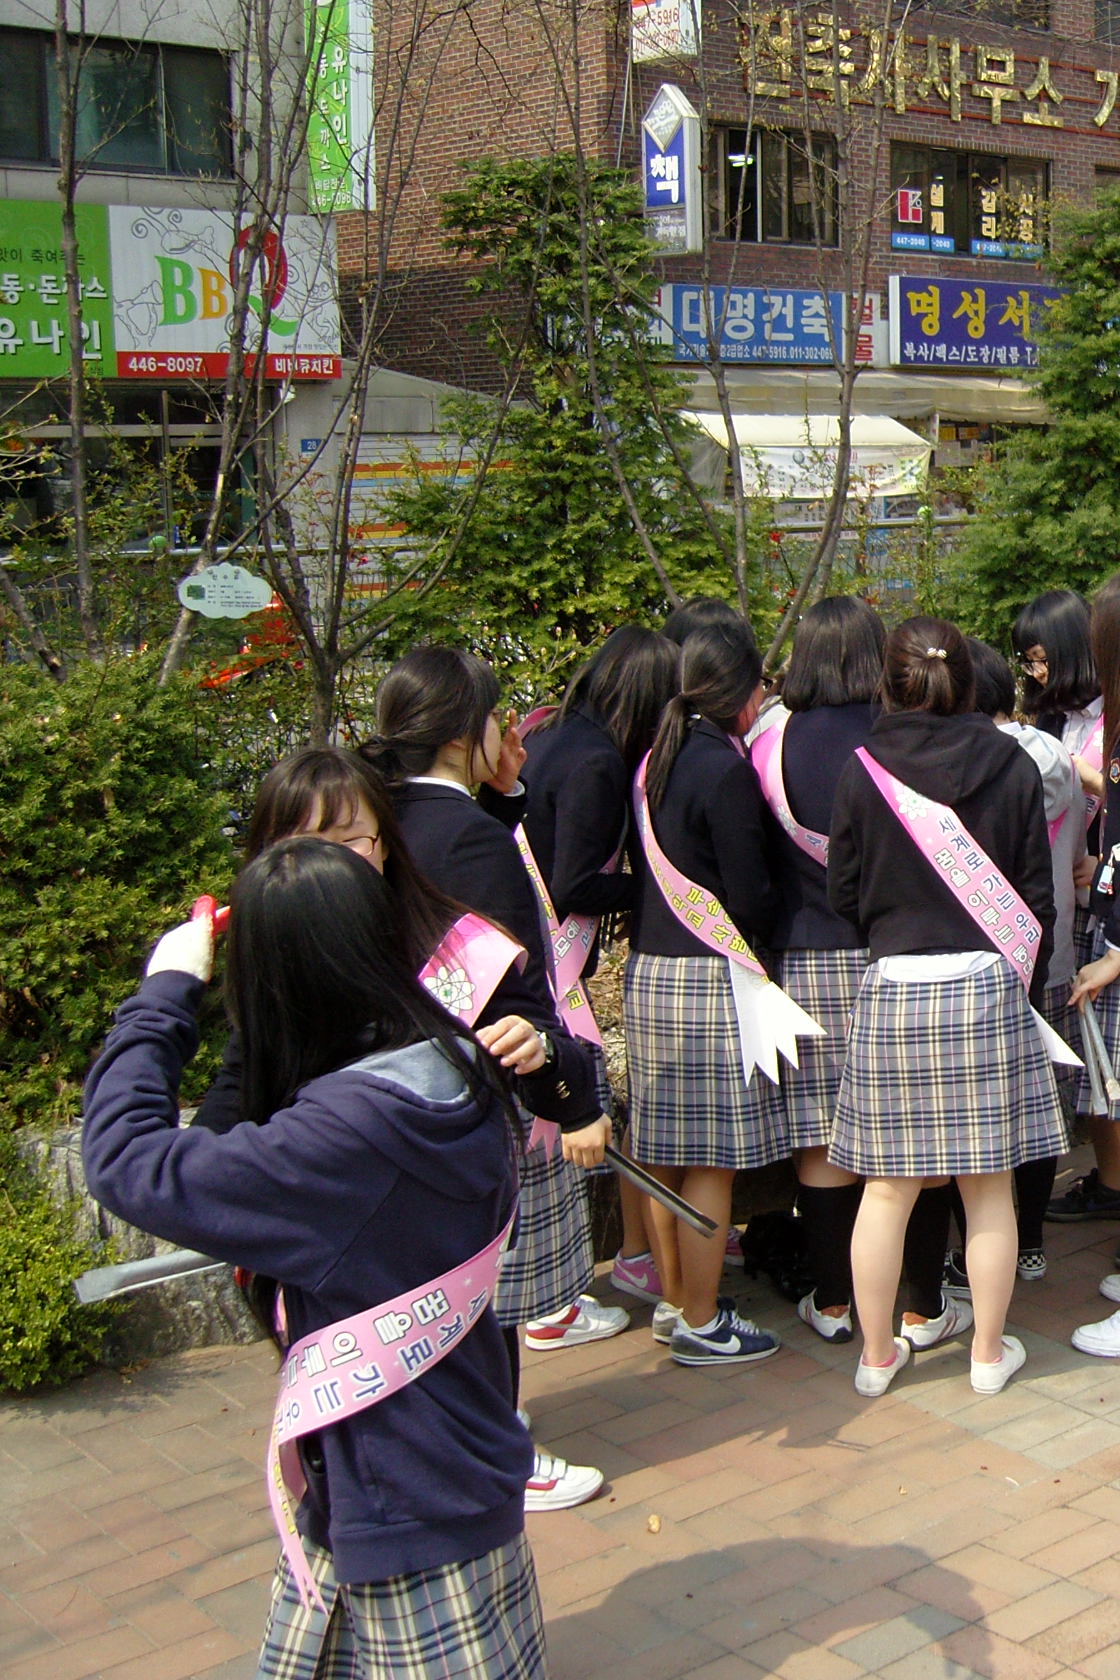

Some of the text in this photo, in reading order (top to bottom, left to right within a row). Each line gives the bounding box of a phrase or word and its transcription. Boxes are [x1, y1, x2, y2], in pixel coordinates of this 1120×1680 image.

[332, 46, 348, 145] 유나인
[650, 153, 680, 204] 책
[981, 190, 996, 240] 감리
[155, 225, 298, 337] BBQ
[682, 290, 833, 341] 대명건축
[906, 285, 1073, 342] 명성서
[129, 357, 203, 373] 446-8097
[937, 816, 985, 871] 세계로
[983, 874, 1015, 910] 가는
[933, 847, 971, 888] 꿈을
[967, 889, 1015, 945] 이루는
[313, 1364, 387, 1415] 가는
